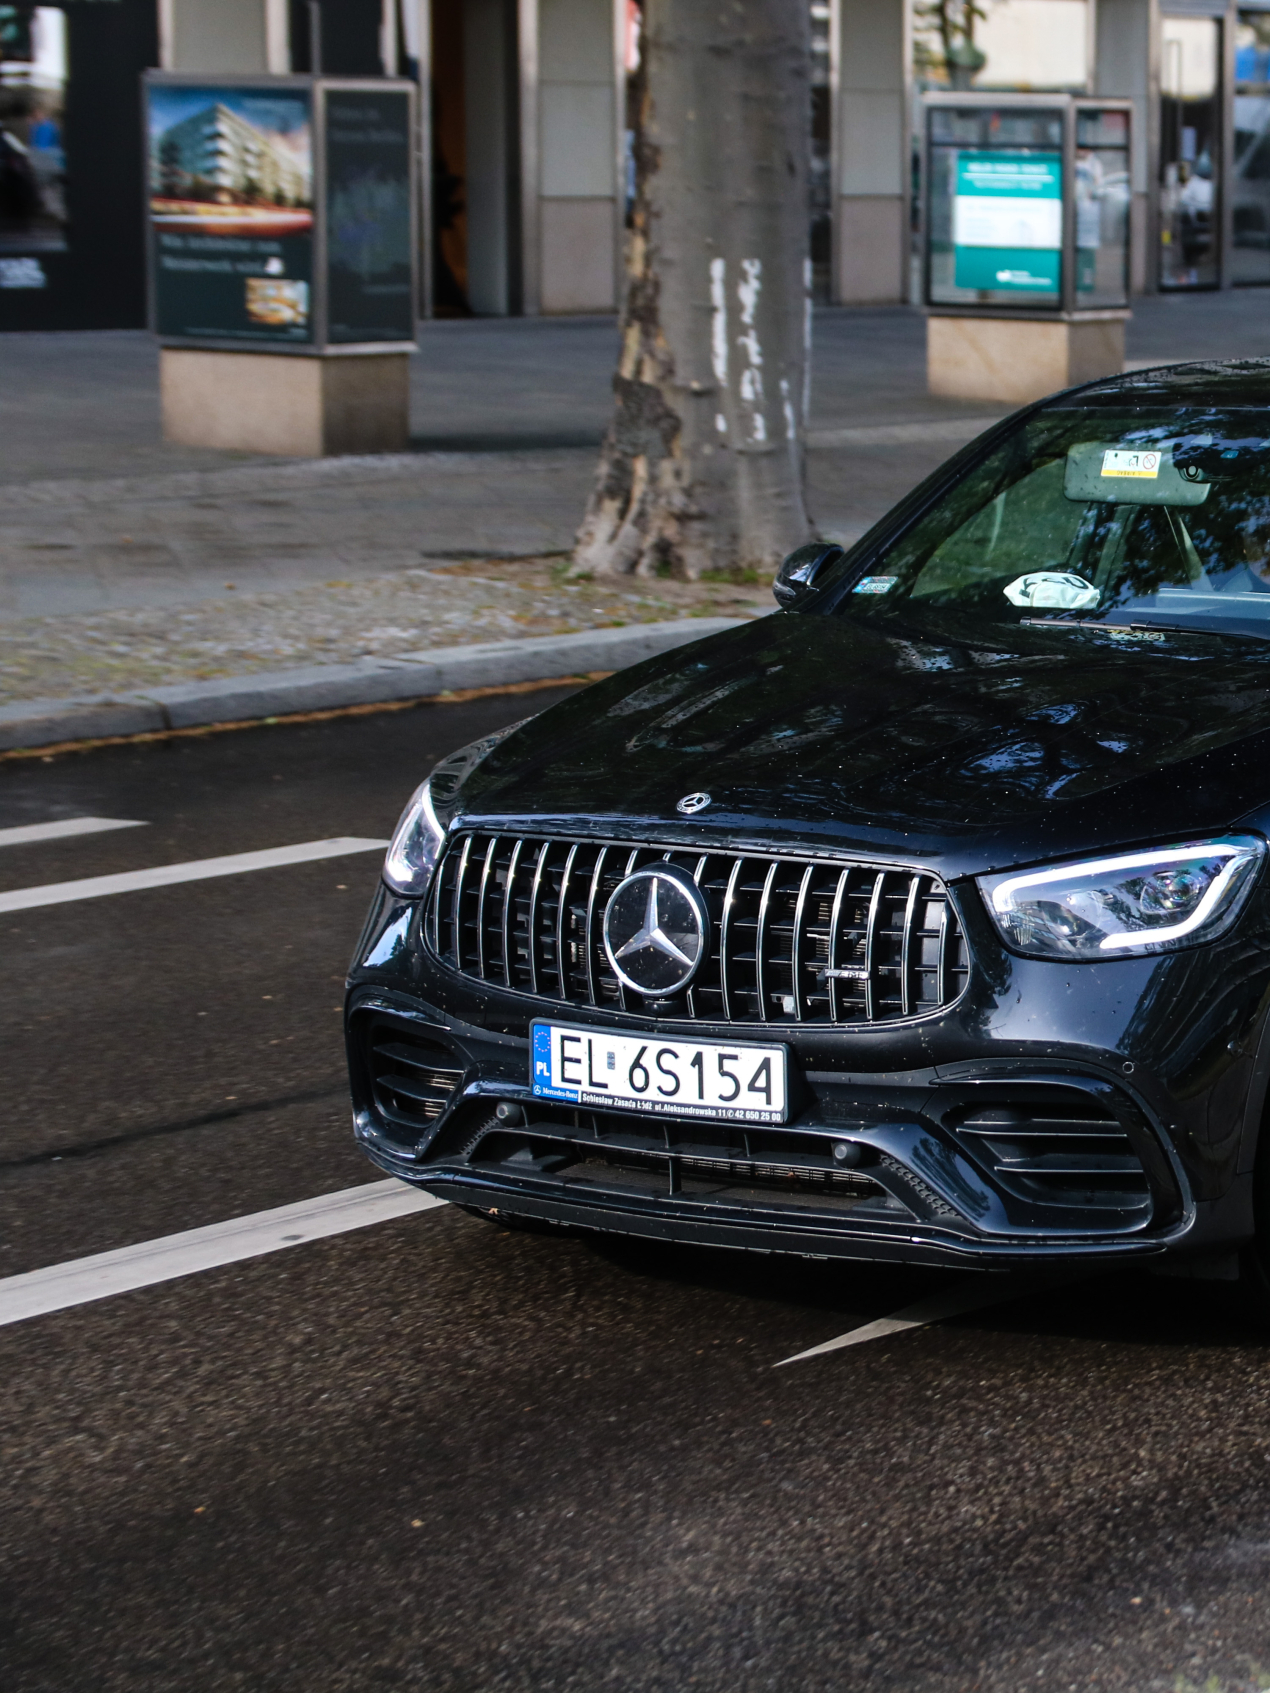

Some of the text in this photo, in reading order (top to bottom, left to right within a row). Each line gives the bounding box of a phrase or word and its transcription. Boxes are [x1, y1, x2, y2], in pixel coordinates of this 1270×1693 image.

[536, 1061, 550, 1077] PL
[560, 1034, 772, 1106] EL 6S154
[542, 1087, 579, 1099] Mercedes-Benz
[614, 1097, 636, 1108] Zasada
[735, 1109, 744, 1118] 42
[746, 1110, 760, 1120] 650
[761, 1112, 770, 1120] 25
[772, 1112, 781, 1121] 00
